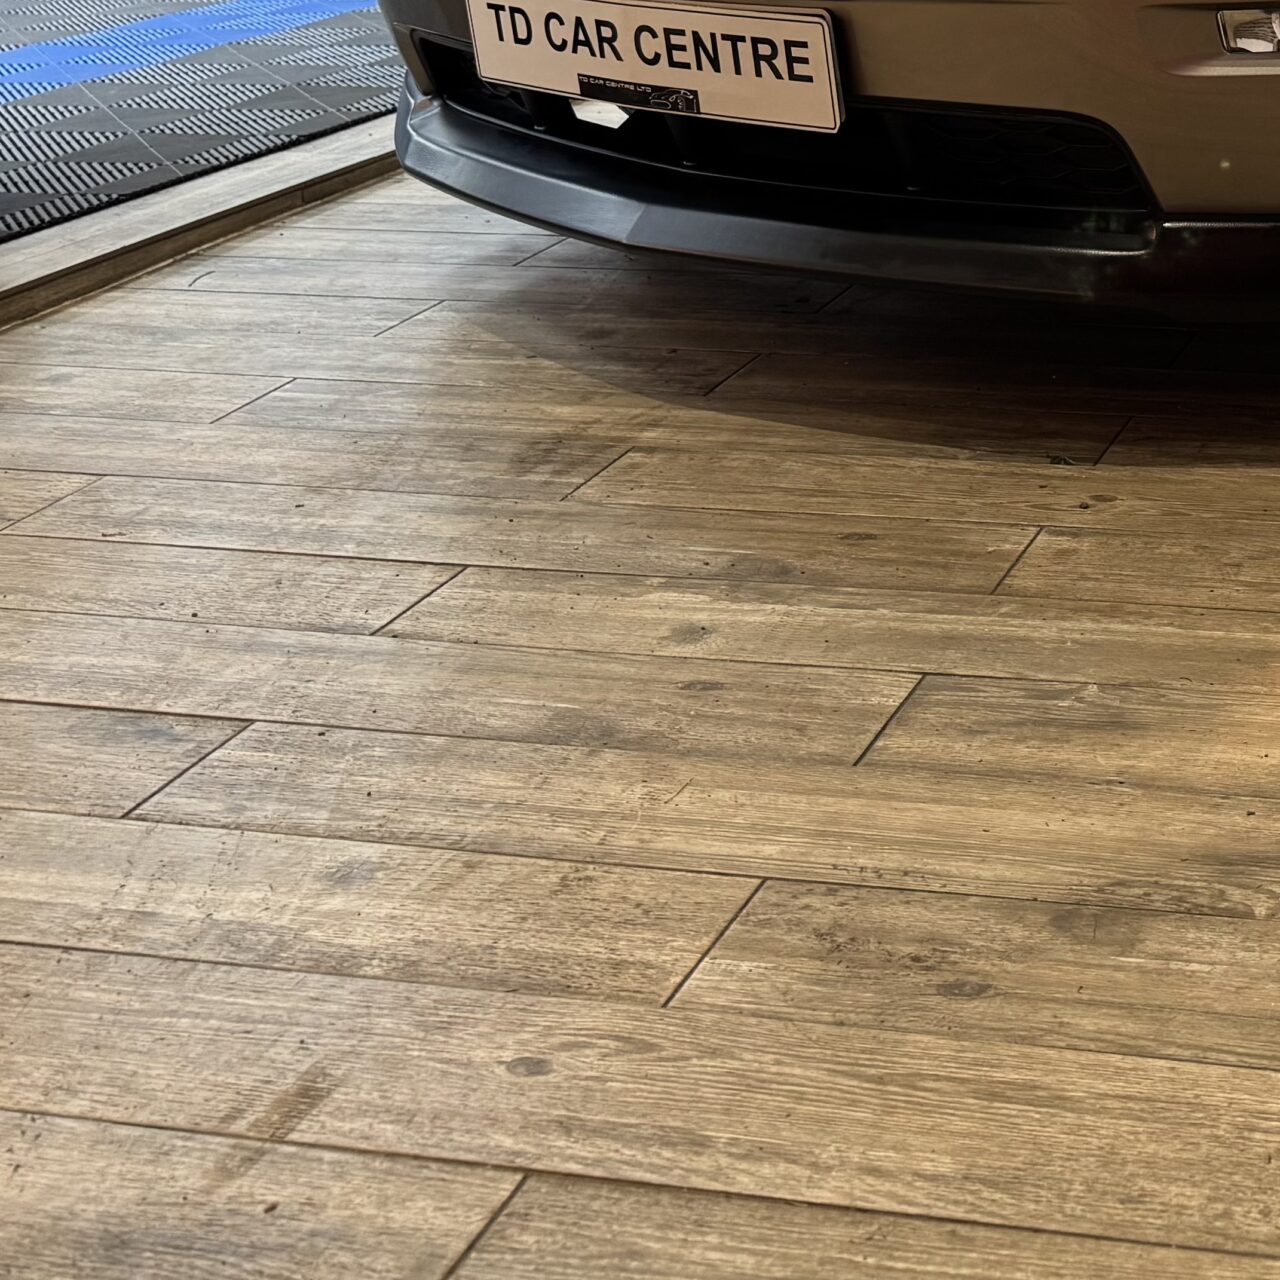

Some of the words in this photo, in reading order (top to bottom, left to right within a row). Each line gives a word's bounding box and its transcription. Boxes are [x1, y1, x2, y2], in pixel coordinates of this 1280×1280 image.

[486, 2, 533, 47] TD
[544, 11, 624, 62] CAR
[634, 24, 815, 84] CENTRE
[605, 80, 635, 91] CENTRE
